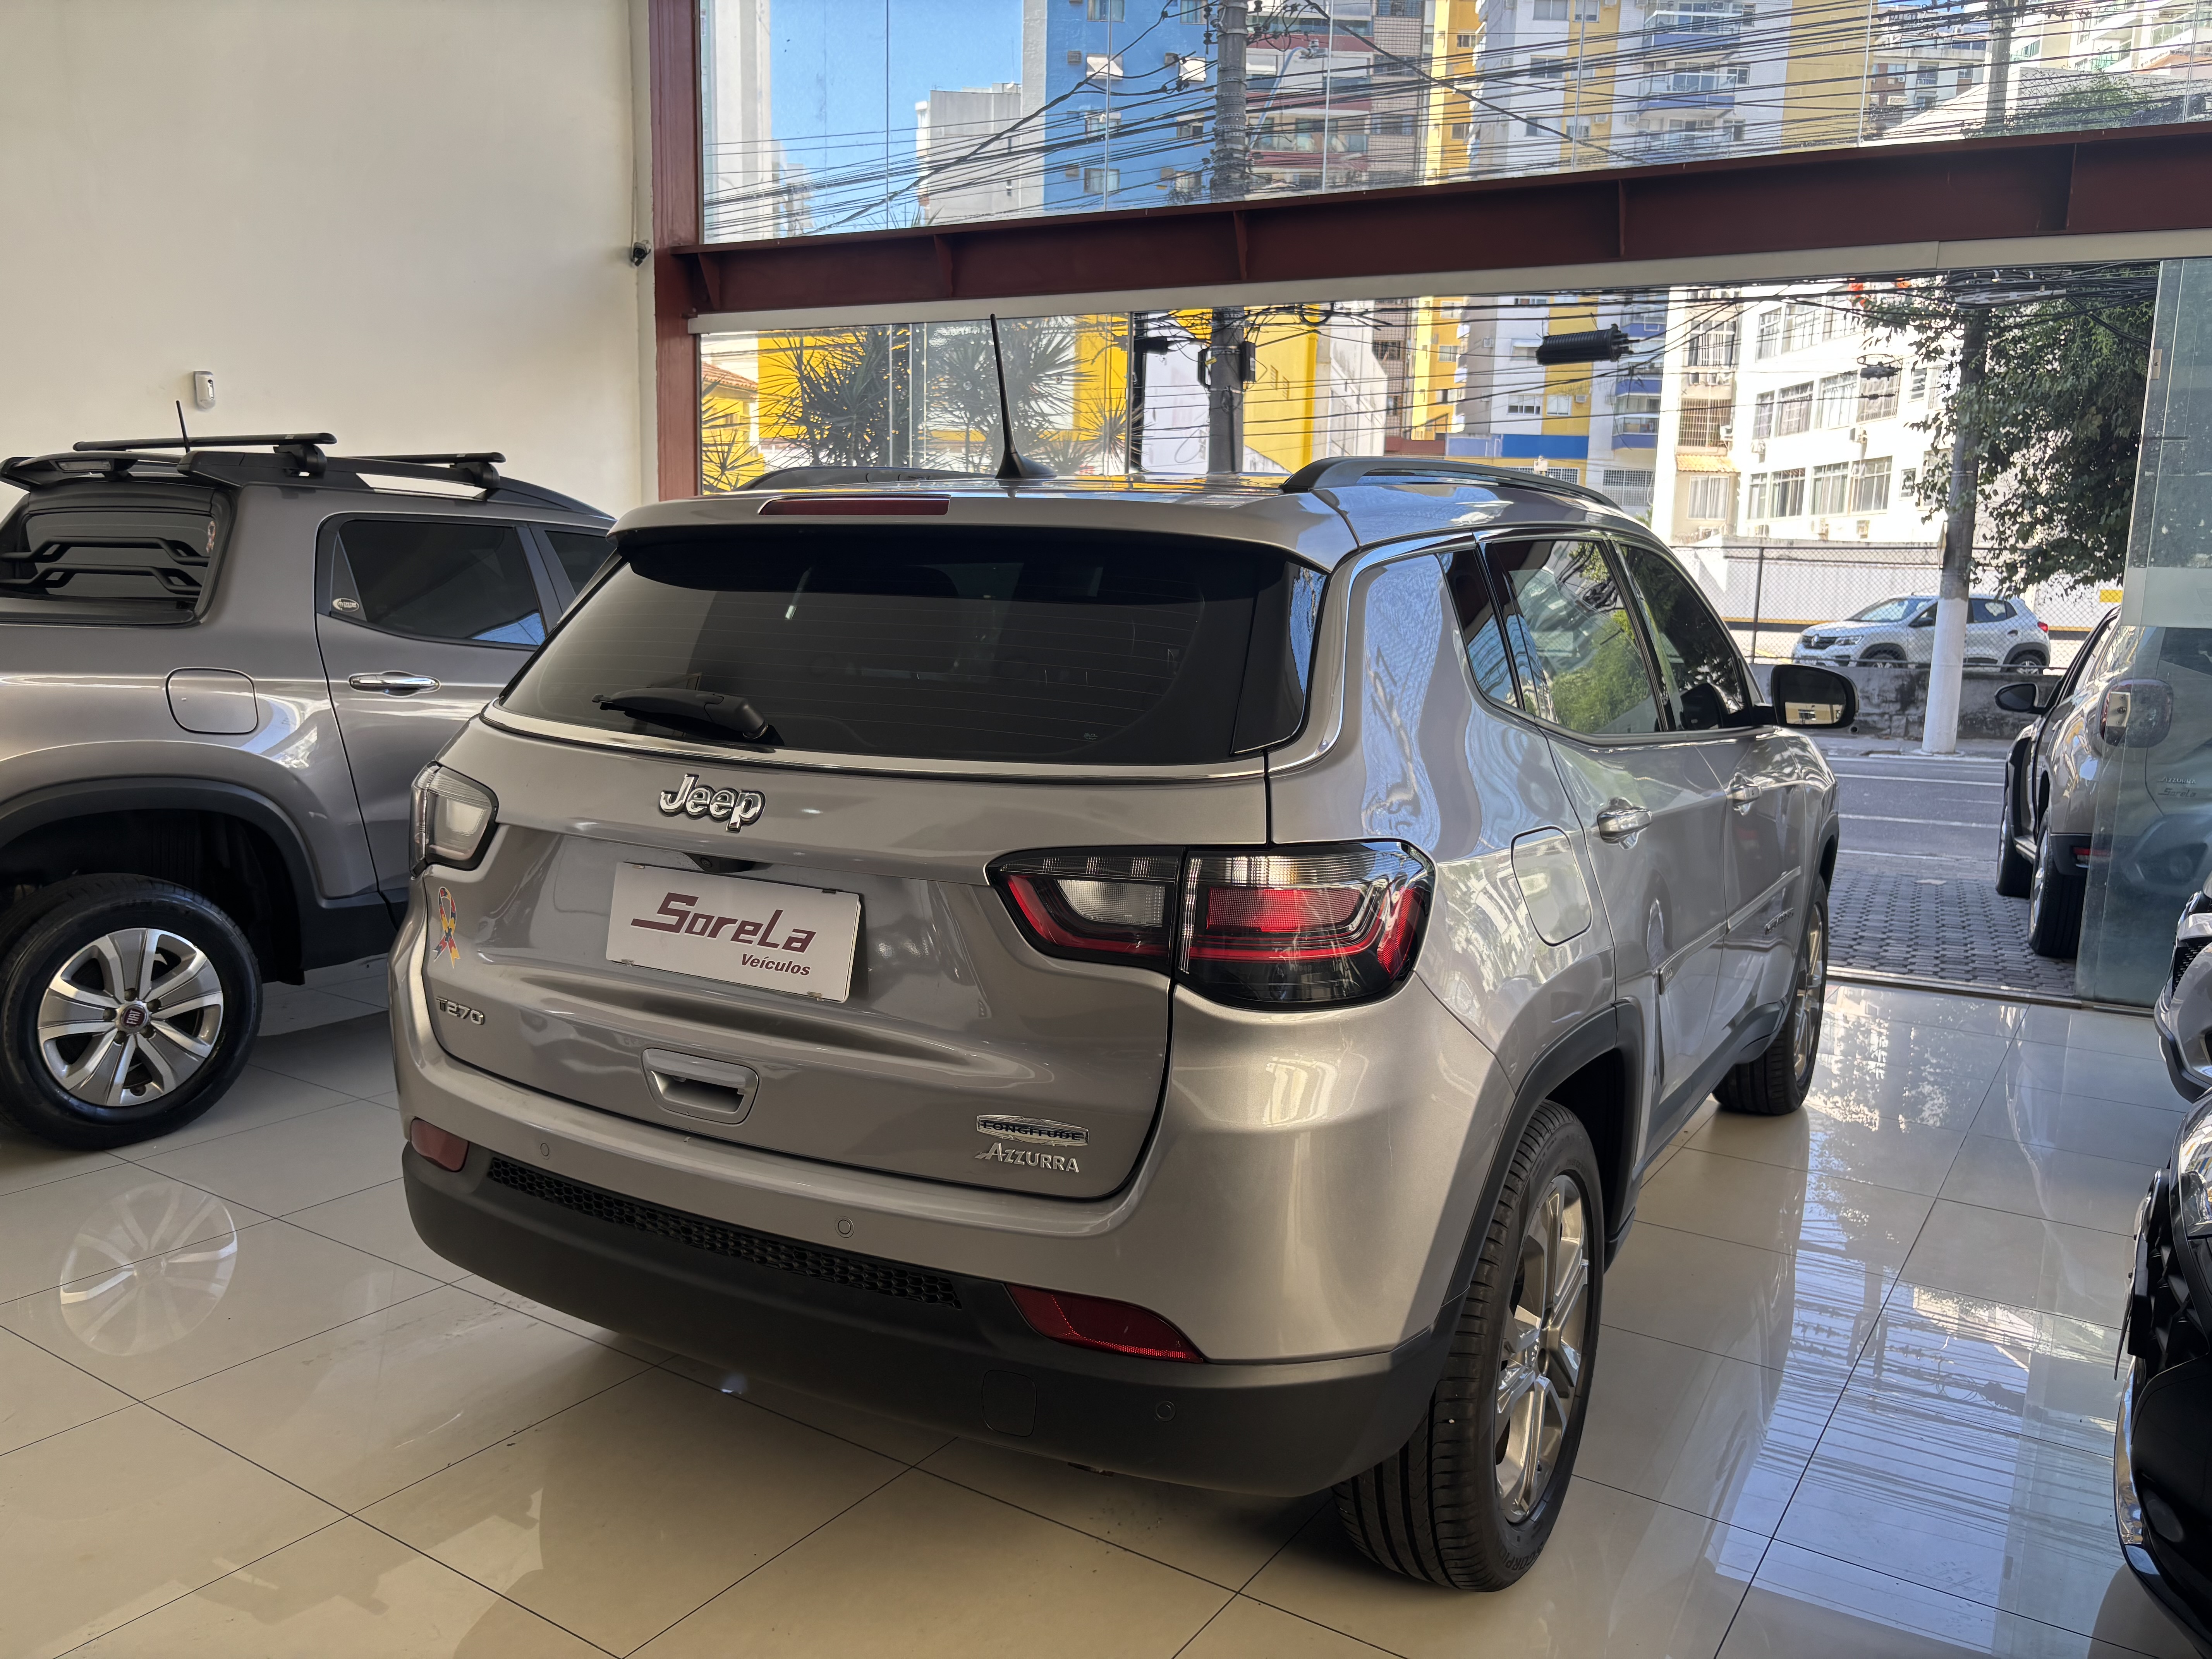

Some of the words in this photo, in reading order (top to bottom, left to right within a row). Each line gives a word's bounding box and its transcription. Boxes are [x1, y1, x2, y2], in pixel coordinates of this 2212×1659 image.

[659, 773, 766, 833] Jeep
[741, 953, 811, 976] Veículos
[126, 1009, 141, 1025] FIAT
[435, 996, 485, 1025] T270
[980, 1120, 1081, 1141] LONGITUDE
